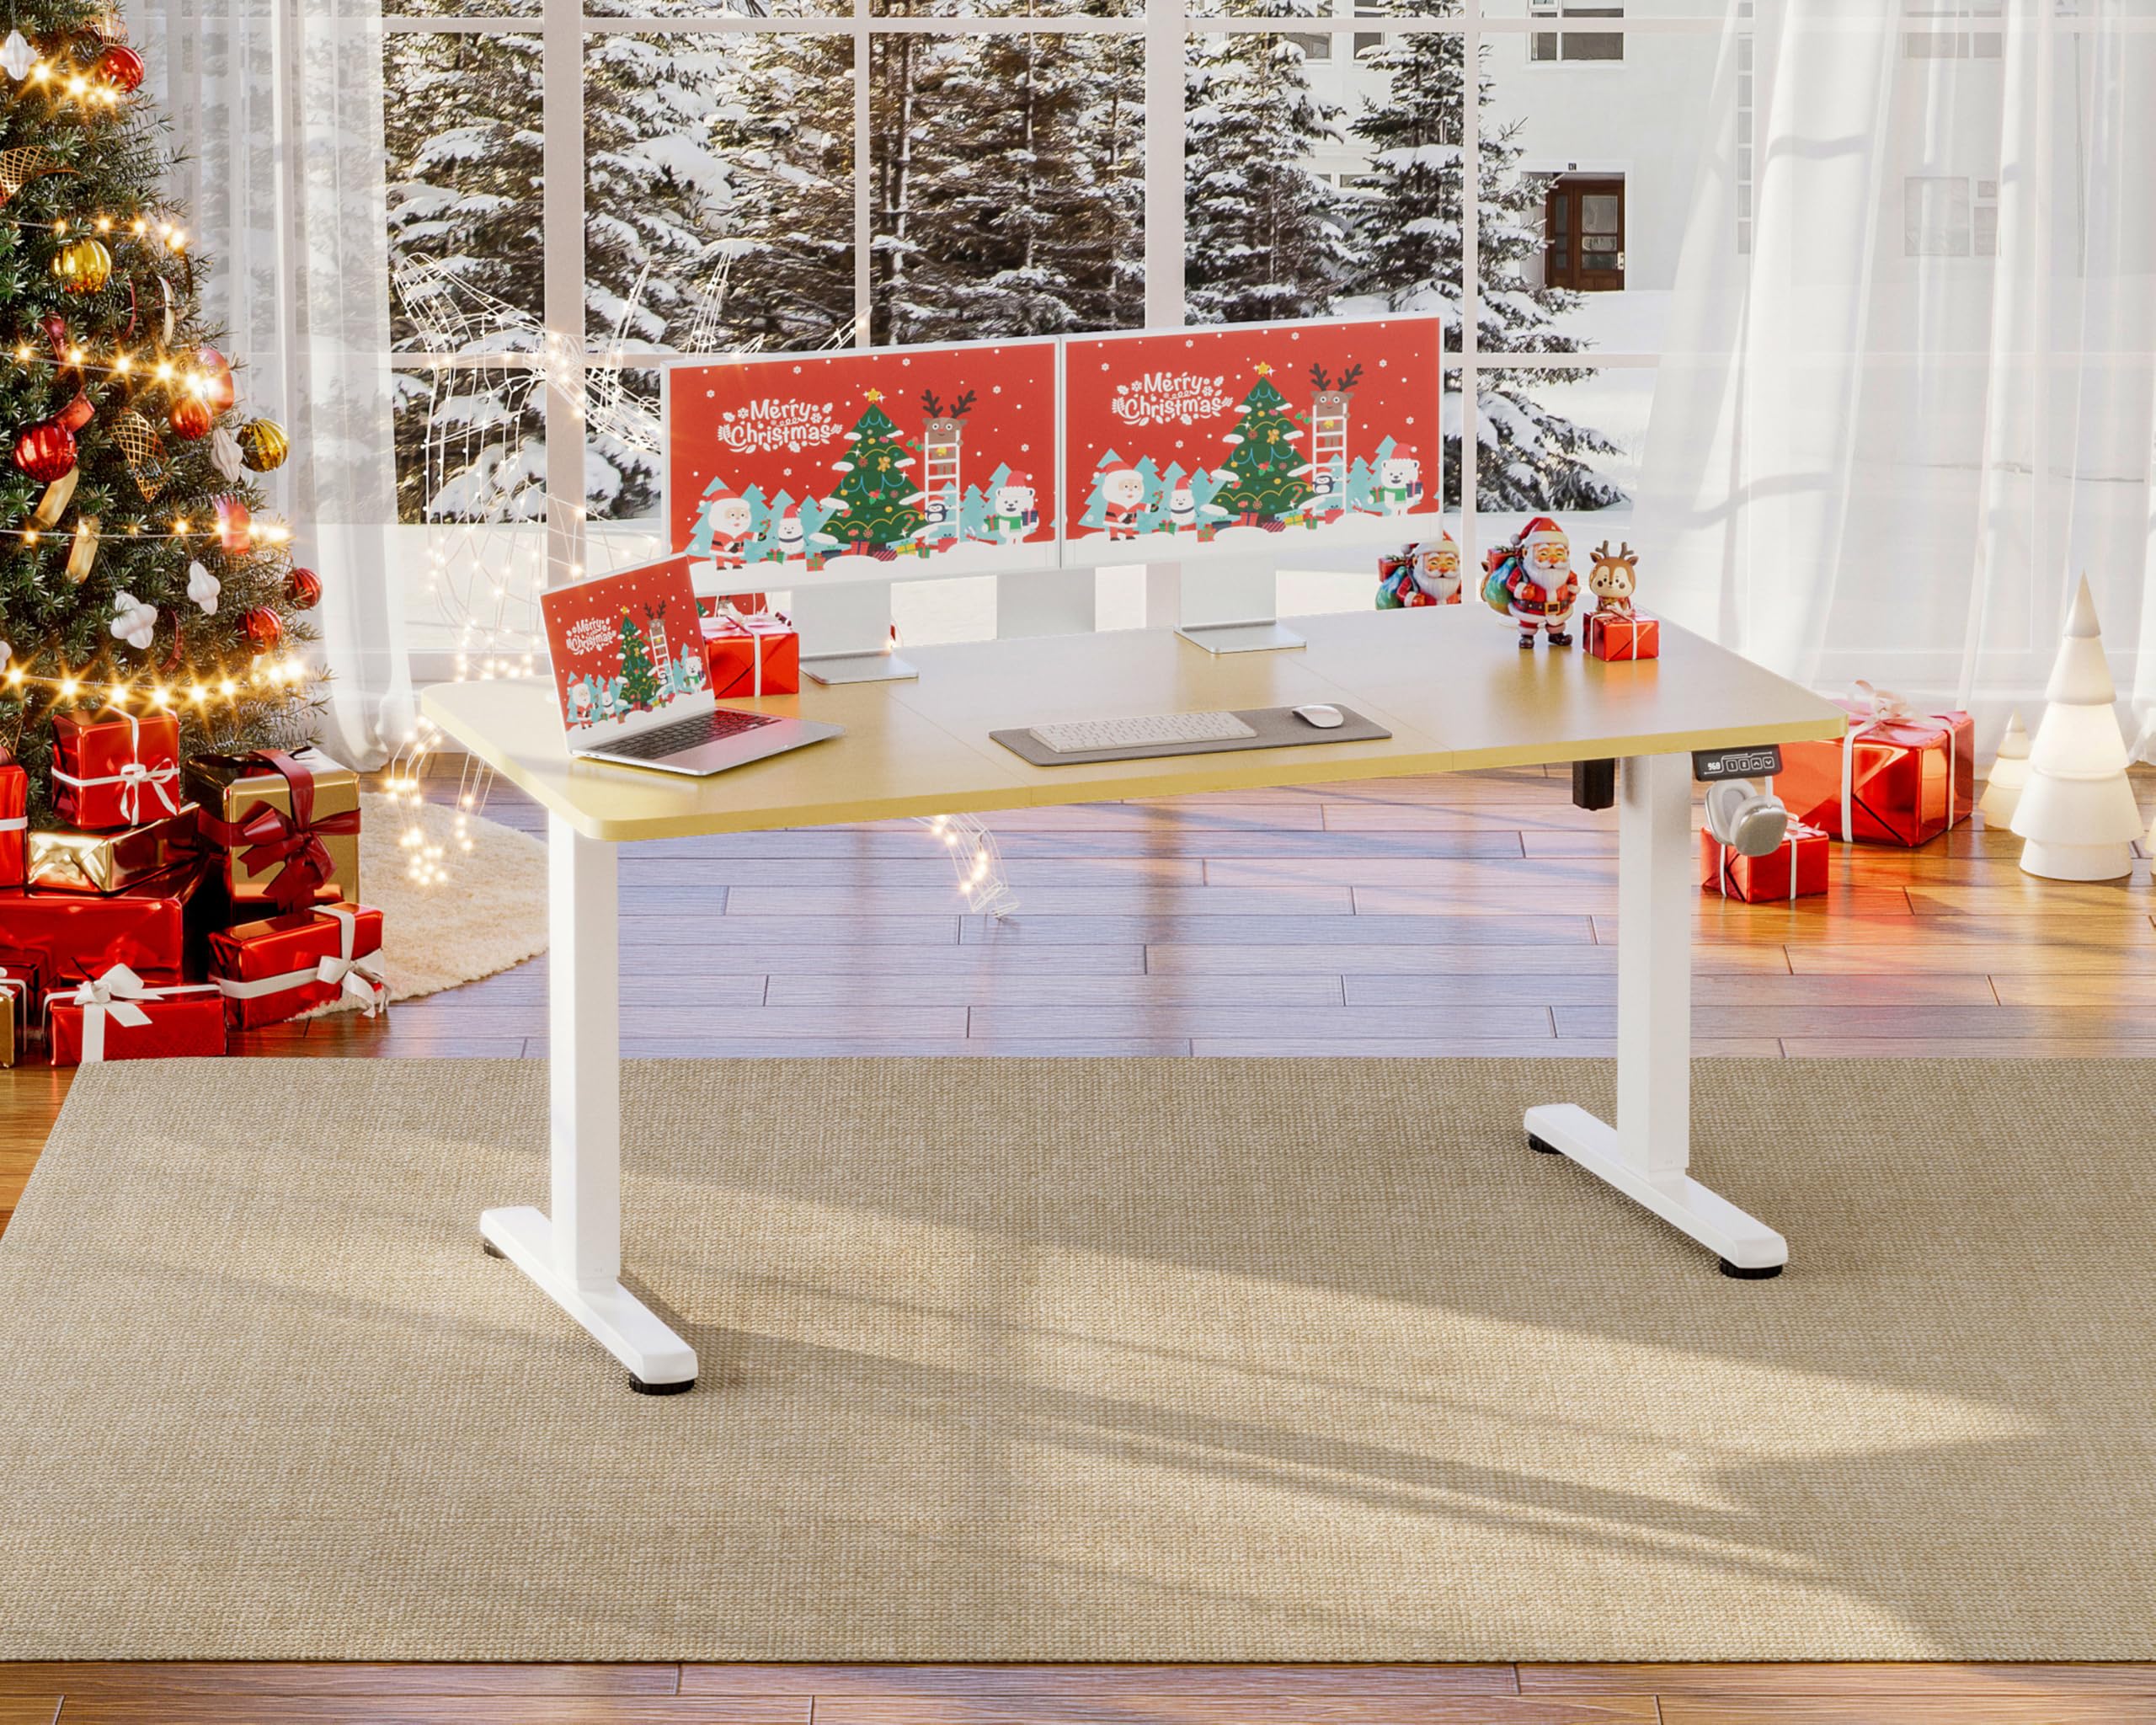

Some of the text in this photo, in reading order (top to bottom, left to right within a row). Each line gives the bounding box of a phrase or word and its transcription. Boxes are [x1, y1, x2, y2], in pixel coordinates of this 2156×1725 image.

[1145, 371, 1203, 395] Merry
[750, 398, 812, 422] Merry
[1125, 394, 1224, 419] Christmas
[731, 421, 832, 446] Christmas
[576, 619, 602, 634] Merry
[571, 631, 613, 651] Christmas
